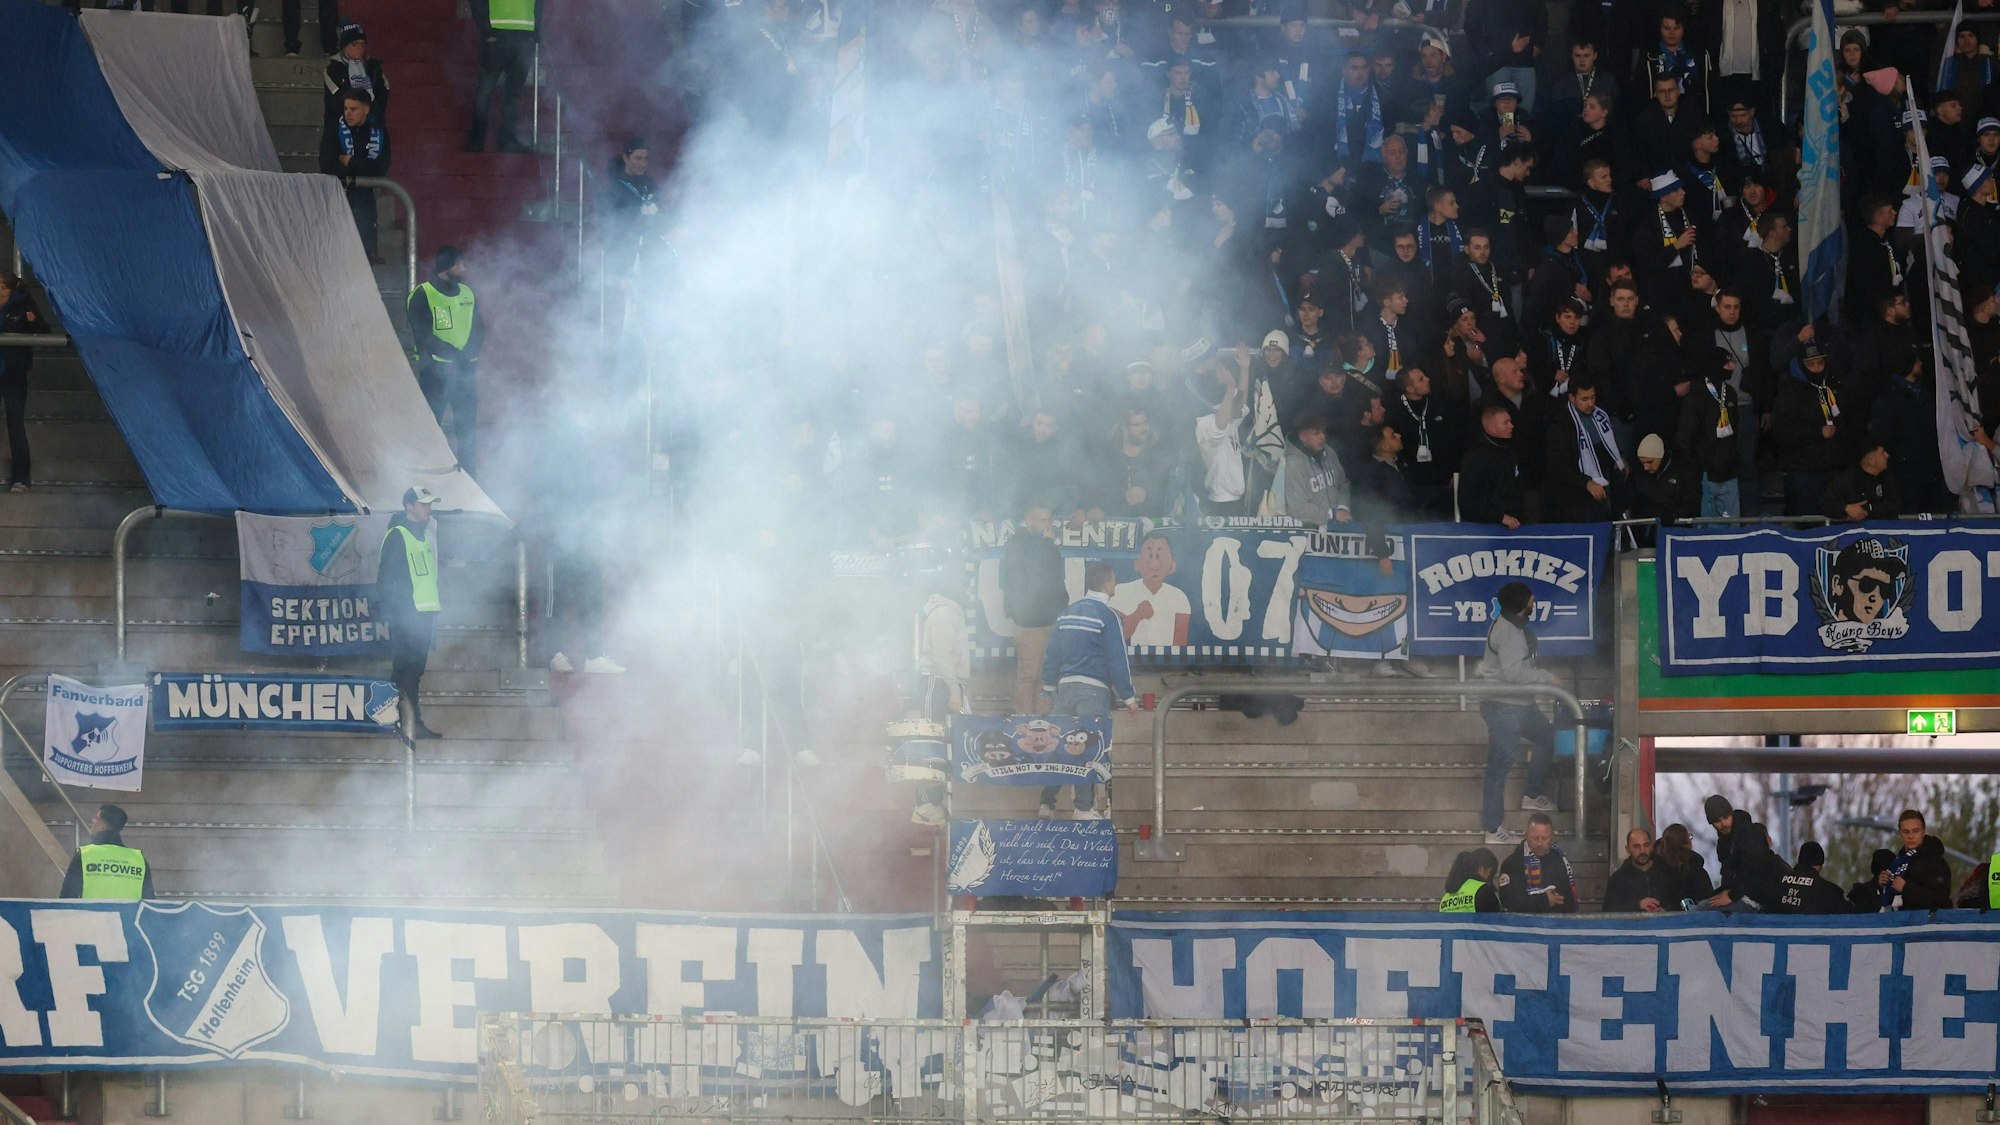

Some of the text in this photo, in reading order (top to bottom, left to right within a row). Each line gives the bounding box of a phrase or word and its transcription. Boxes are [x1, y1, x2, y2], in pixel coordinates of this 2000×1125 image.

[1310, 533, 1395, 556] UNITD
[1418, 549, 1587, 595] ROOKIEZ
[1202, 537, 1307, 644] 07
[1676, 552, 1800, 639] YB
[272, 597, 369, 621] SEKTION
[1454, 600, 1487, 622] YB
[271, 621, 390, 646] EPPINGEN
[1825, 622, 1863, 642] Young
[52, 684, 144, 707] Fanverband
[167, 674, 366, 721] MÜNCHEN
[54, 752, 133, 775] SUPPORTERS HOFFENHEIM
[991, 766, 1014, 776] STILL
[1016, 764, 1031, 772] NOT
[1061, 765, 1087, 775] POLICE
[1072, 820, 1098, 837] Rolle
[1060, 839, 1080, 851] Das
[1070, 855, 1098, 868] Verein
[1000, 869, 1031, 883] Herzen
[1781, 875, 1814, 887] POLIZEI
[1781, 896, 1802, 907] 6421
[1787, 888, 1800, 897] BY
[177, 931, 226, 1002] TSG 1899
[198, 958, 256, 1040] Hoffenheim
[282, 912, 932, 1070] VEREIN
